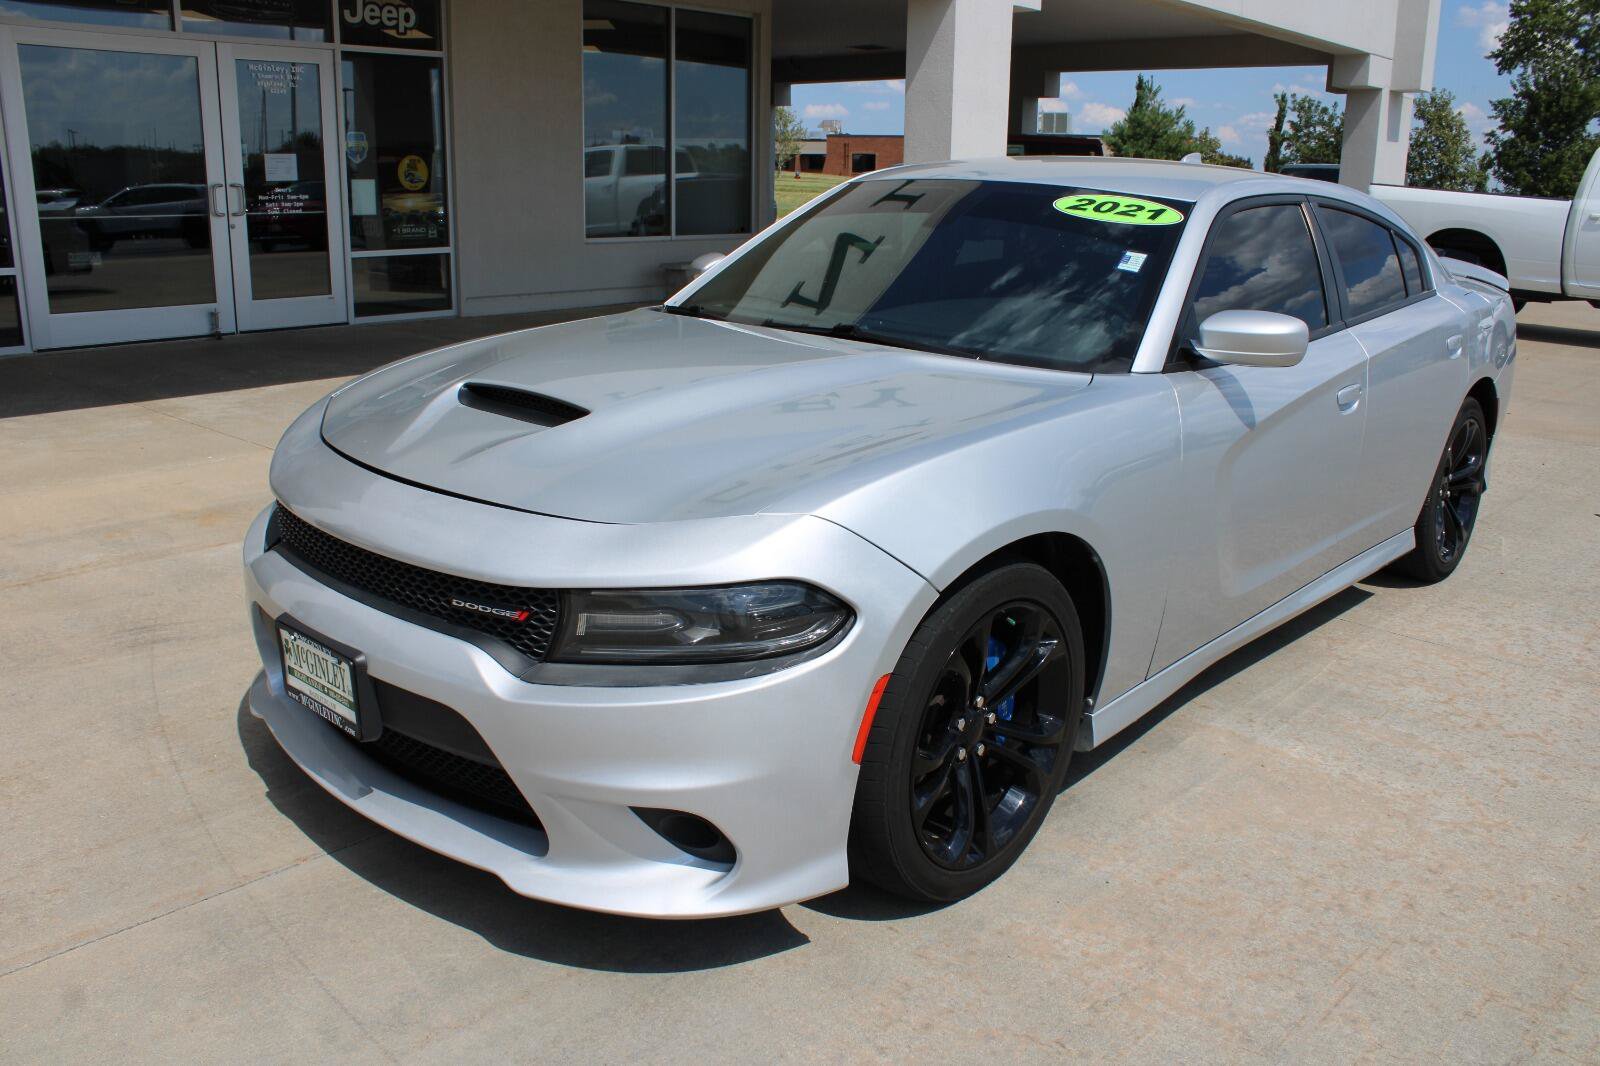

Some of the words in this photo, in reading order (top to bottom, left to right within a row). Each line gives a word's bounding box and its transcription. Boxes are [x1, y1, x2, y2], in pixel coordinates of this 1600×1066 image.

[343, 0, 416, 33] Jeep
[1065, 198, 1168, 221] 2021
[452, 599, 520, 619] DODGE
